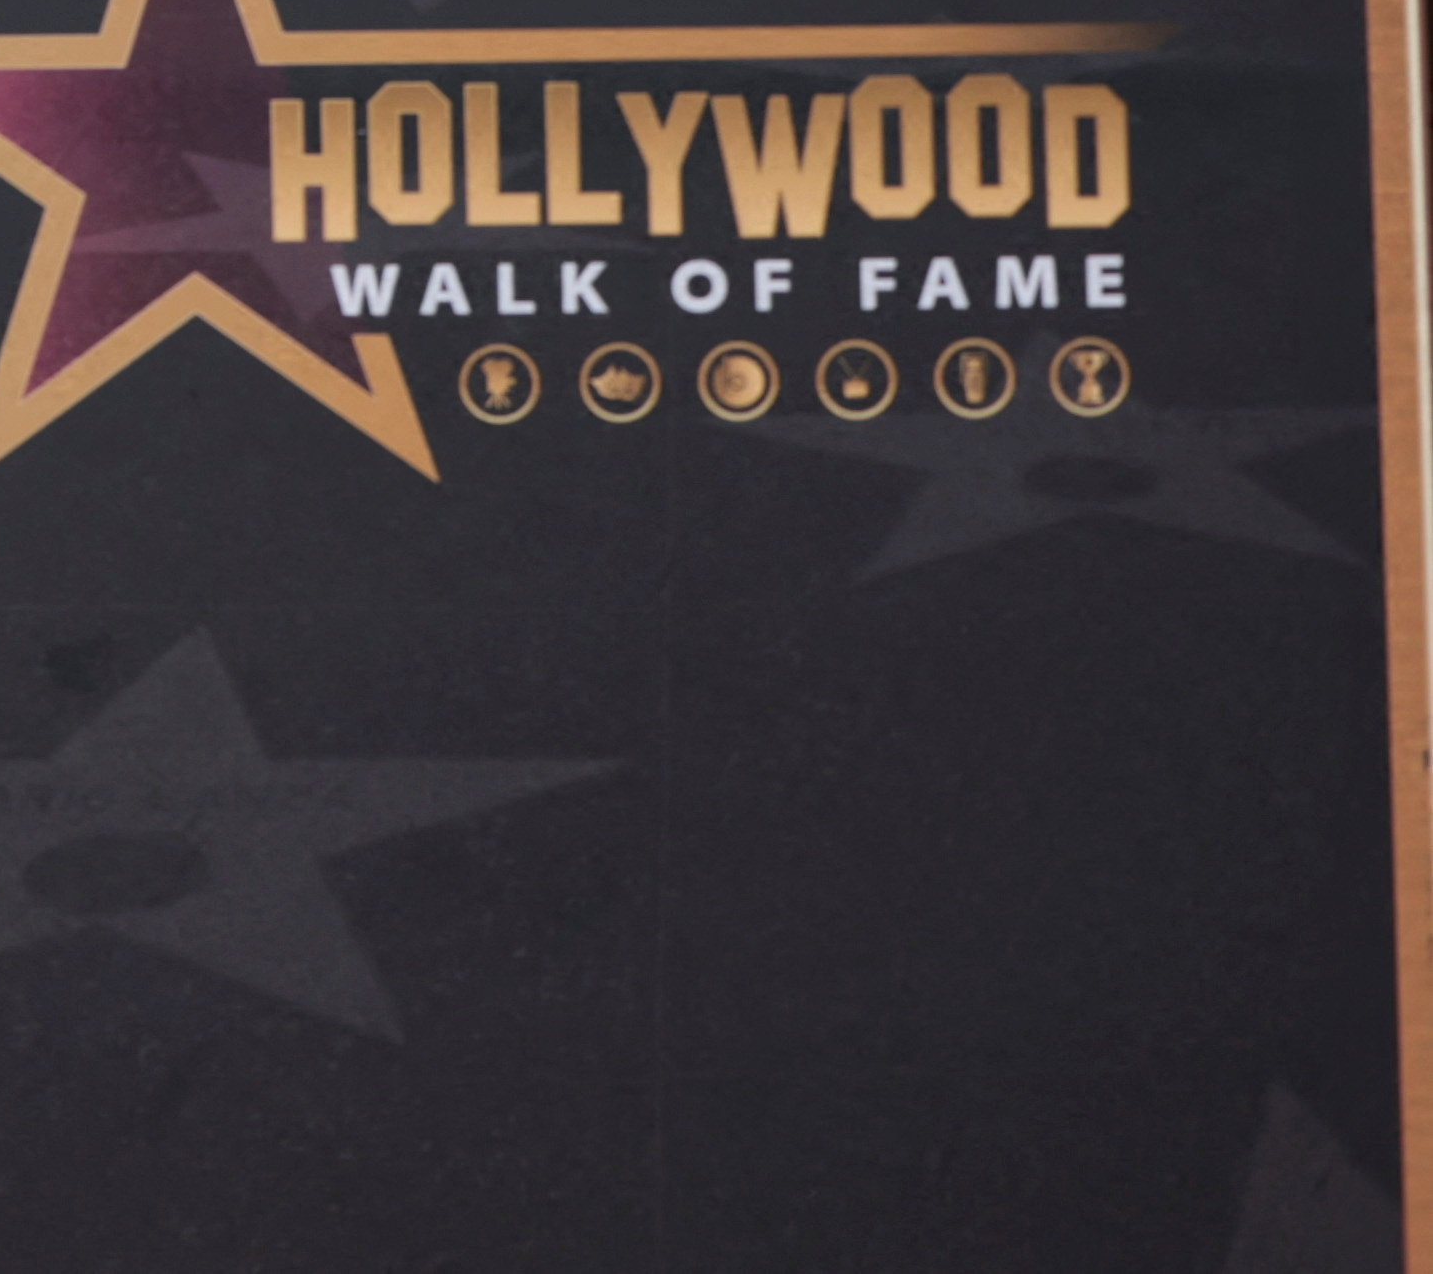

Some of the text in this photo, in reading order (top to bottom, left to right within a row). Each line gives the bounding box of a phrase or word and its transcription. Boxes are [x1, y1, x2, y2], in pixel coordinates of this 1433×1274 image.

[269, 73, 1131, 243] HOLLYWOOD
[330, 255, 1128, 317] WALK OF FAME
